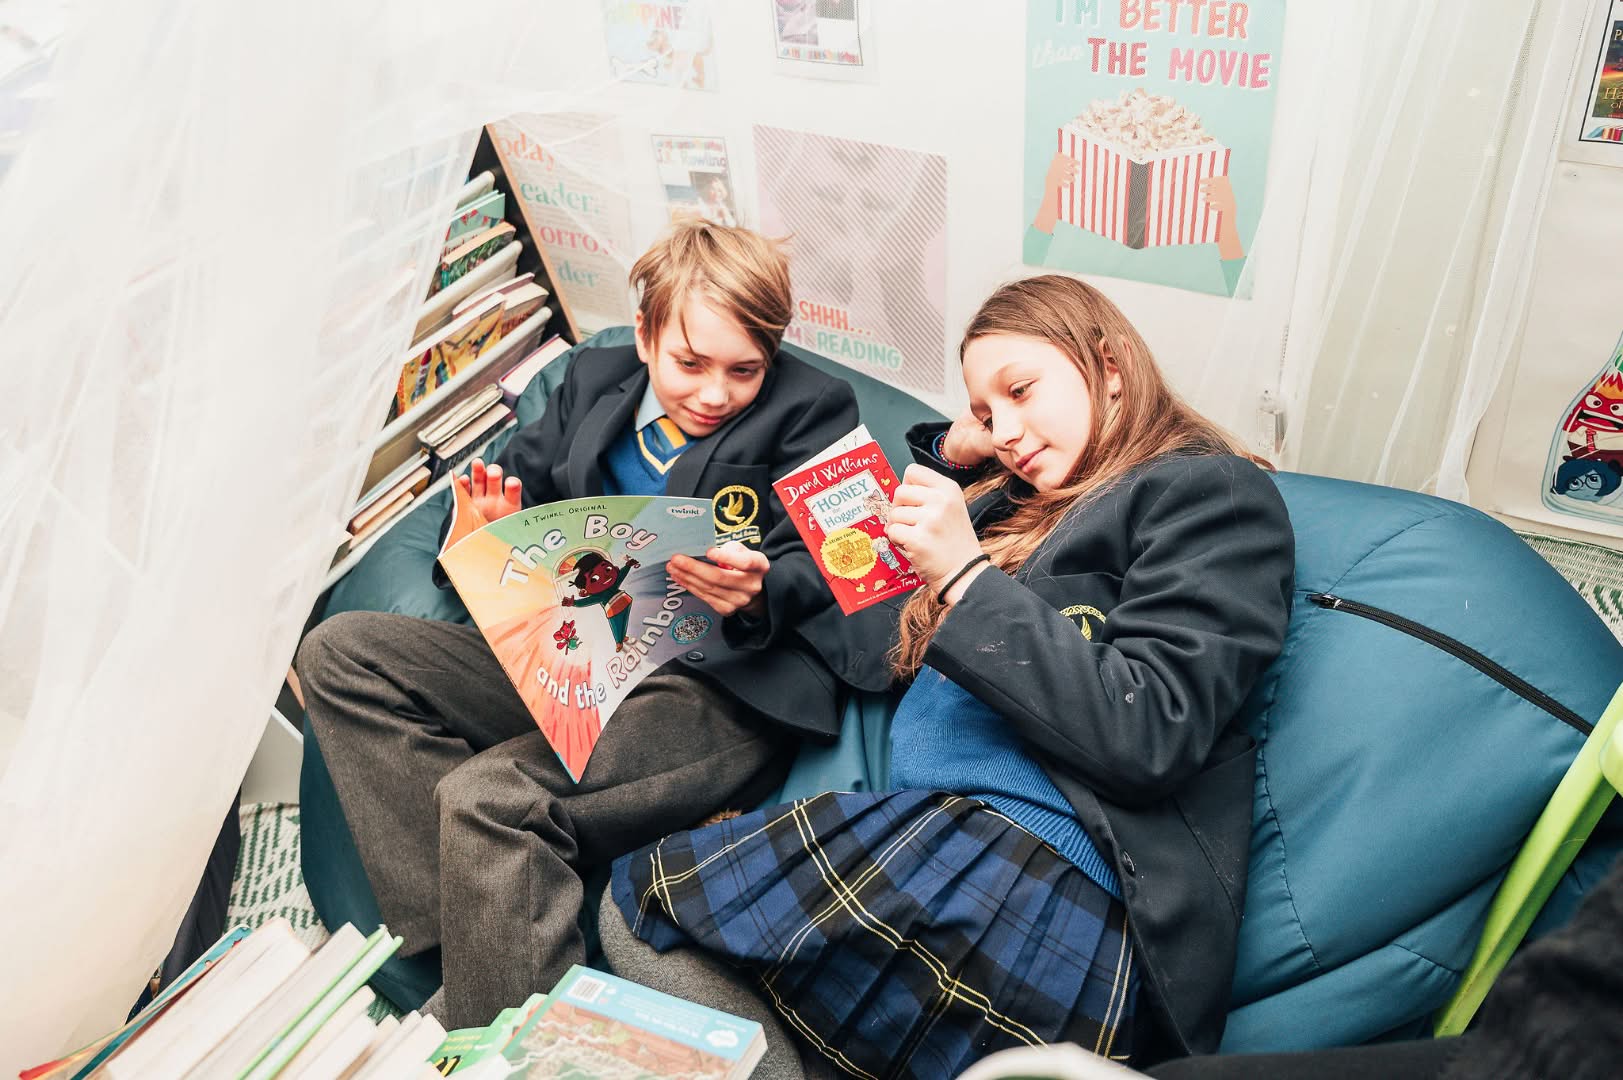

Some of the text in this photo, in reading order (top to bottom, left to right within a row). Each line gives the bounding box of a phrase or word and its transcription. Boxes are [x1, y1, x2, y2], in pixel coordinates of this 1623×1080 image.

[1055, 0, 1249, 39] IM BETTER
[1087, 37, 1147, 76] THE
[1168, 47, 1271, 88] MOVIE
[499, 132, 555, 171] oday
[540, 225, 616, 255] orro
[558, 260, 600, 287] der
[816, 331, 902, 369] READING
[783, 453, 878, 506] David Walliams
[815, 478, 870, 513] HONEY
[824, 505, 863, 529] Hogger
[499, 514, 658, 587] The Boy
[536, 667, 571, 706] and
[574, 681, 607, 710] the
